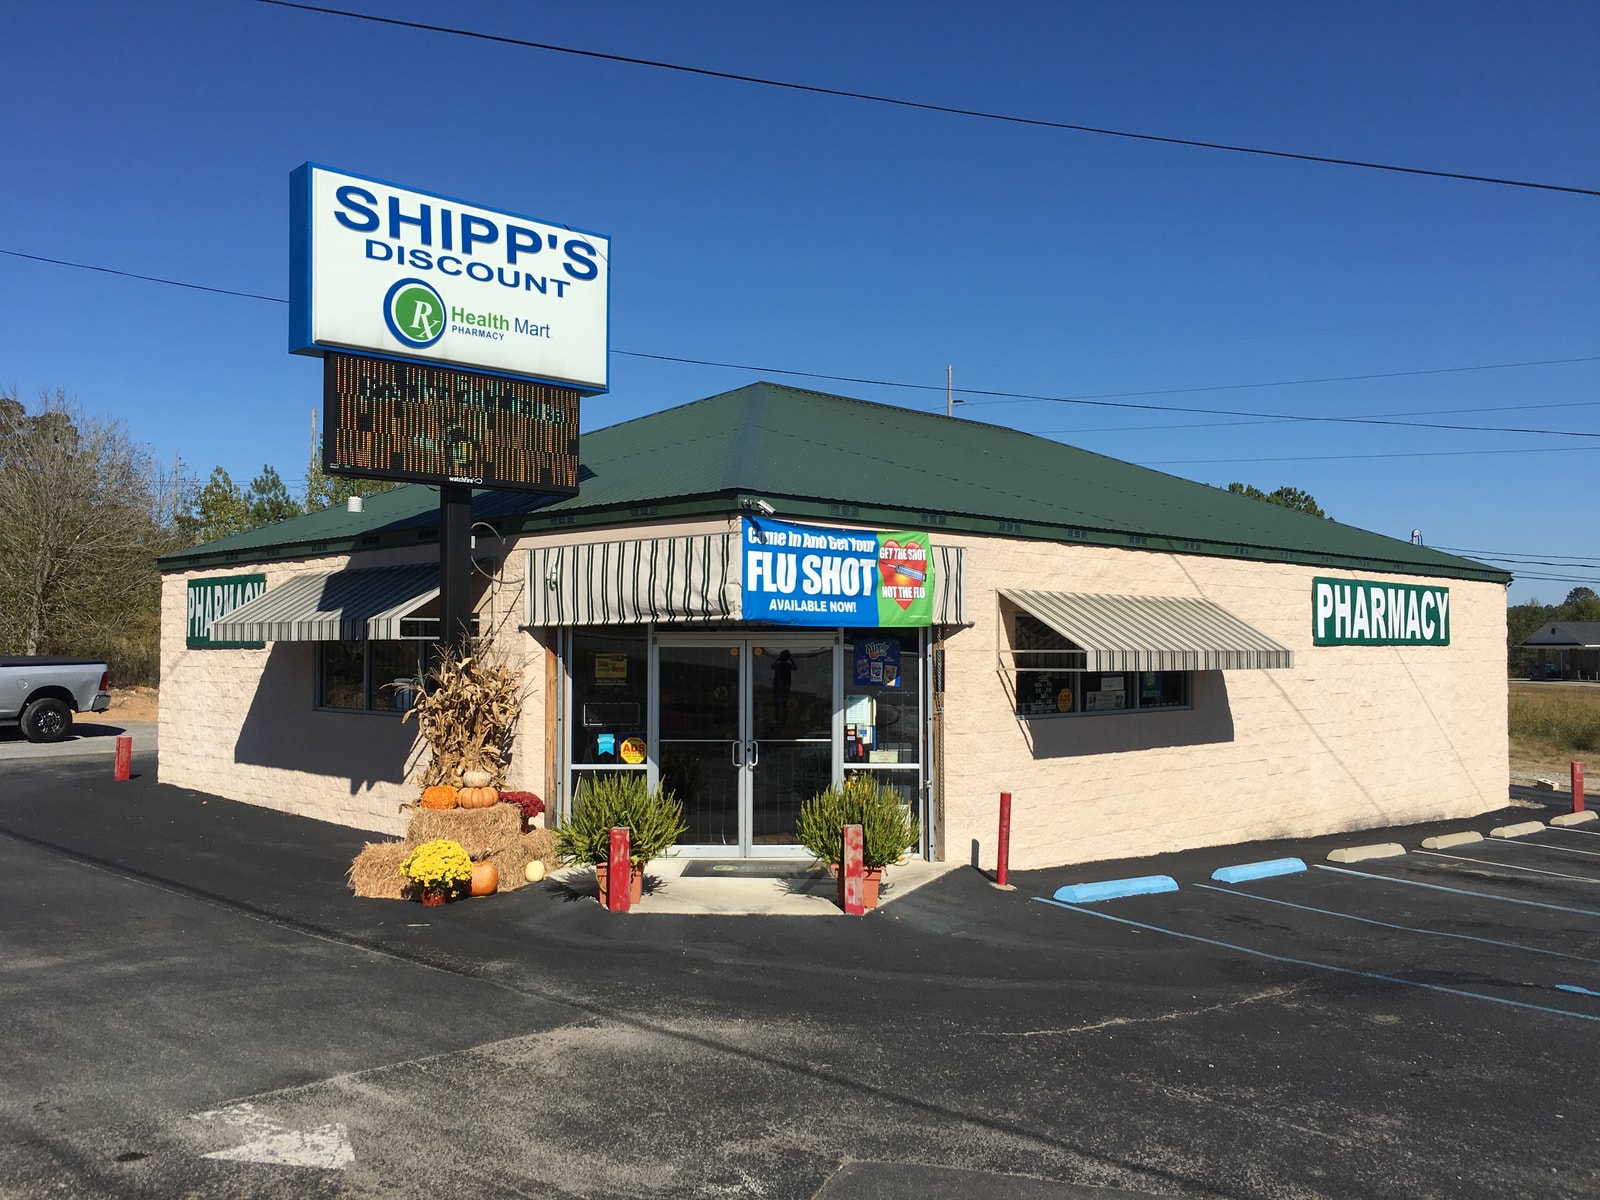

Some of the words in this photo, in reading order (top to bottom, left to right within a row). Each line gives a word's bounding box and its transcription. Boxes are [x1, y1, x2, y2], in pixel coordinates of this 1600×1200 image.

[333, 184, 599, 281] SHIPP'S
[365, 238, 571, 298] DISCOUNT
[451, 306, 510, 331] Health
[514, 317, 551, 339] Mart
[451, 325, 505, 341] PHARMACY
[747, 526, 787, 547] Come
[788, 530, 801, 548] In
[802, 533, 827, 550] And
[827, 535, 849, 551] Get
[847, 537, 876, 553] Your
[879, 547, 894, 560] GET
[893, 547, 907, 560] THE
[906, 548, 927, 561] SHOT
[747, 550, 797, 594] FLU
[802, 553, 877, 597] SHOT
[768, 598, 827, 612] AVAILABLE
[829, 600, 857, 613] NOW!
[881, 585, 897, 598] NOT
[898, 586, 913, 599] THE
[913, 586, 926, 599] FLU
[1316, 583, 1449, 640] PHARMACY
[622, 743, 646, 753] ADS
